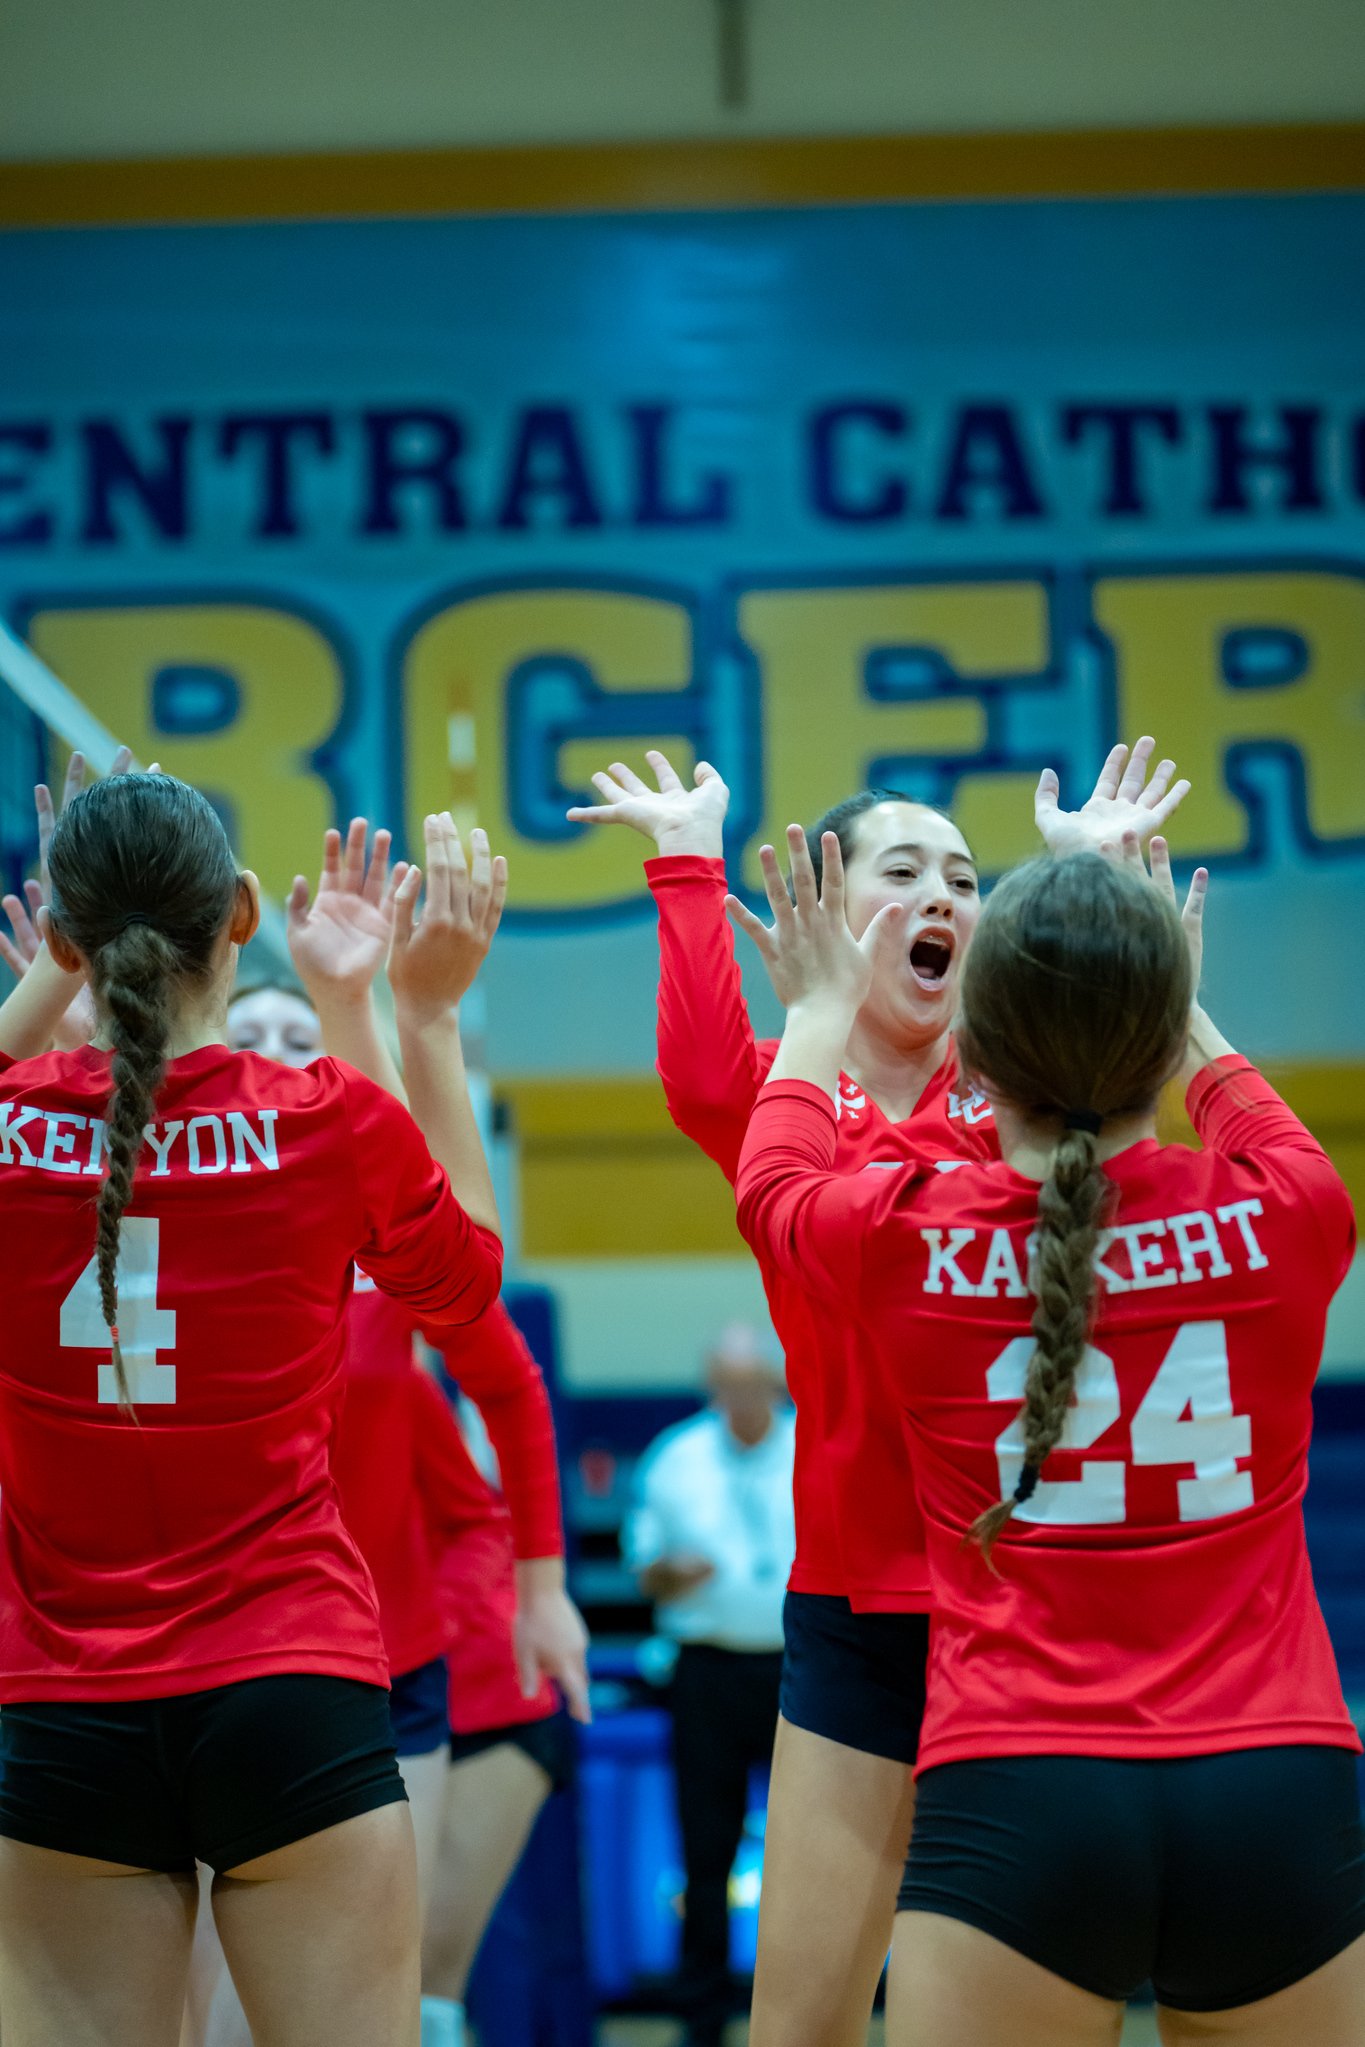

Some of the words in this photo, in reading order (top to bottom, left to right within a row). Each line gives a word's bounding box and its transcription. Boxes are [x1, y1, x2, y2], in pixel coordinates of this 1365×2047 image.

[806, 398, 1365, 524] CATH
[60, 1216, 176, 1404] 4
[920, 1198, 1269, 1297] KAKERT
[985, 1319, 1255, 1525] 24
